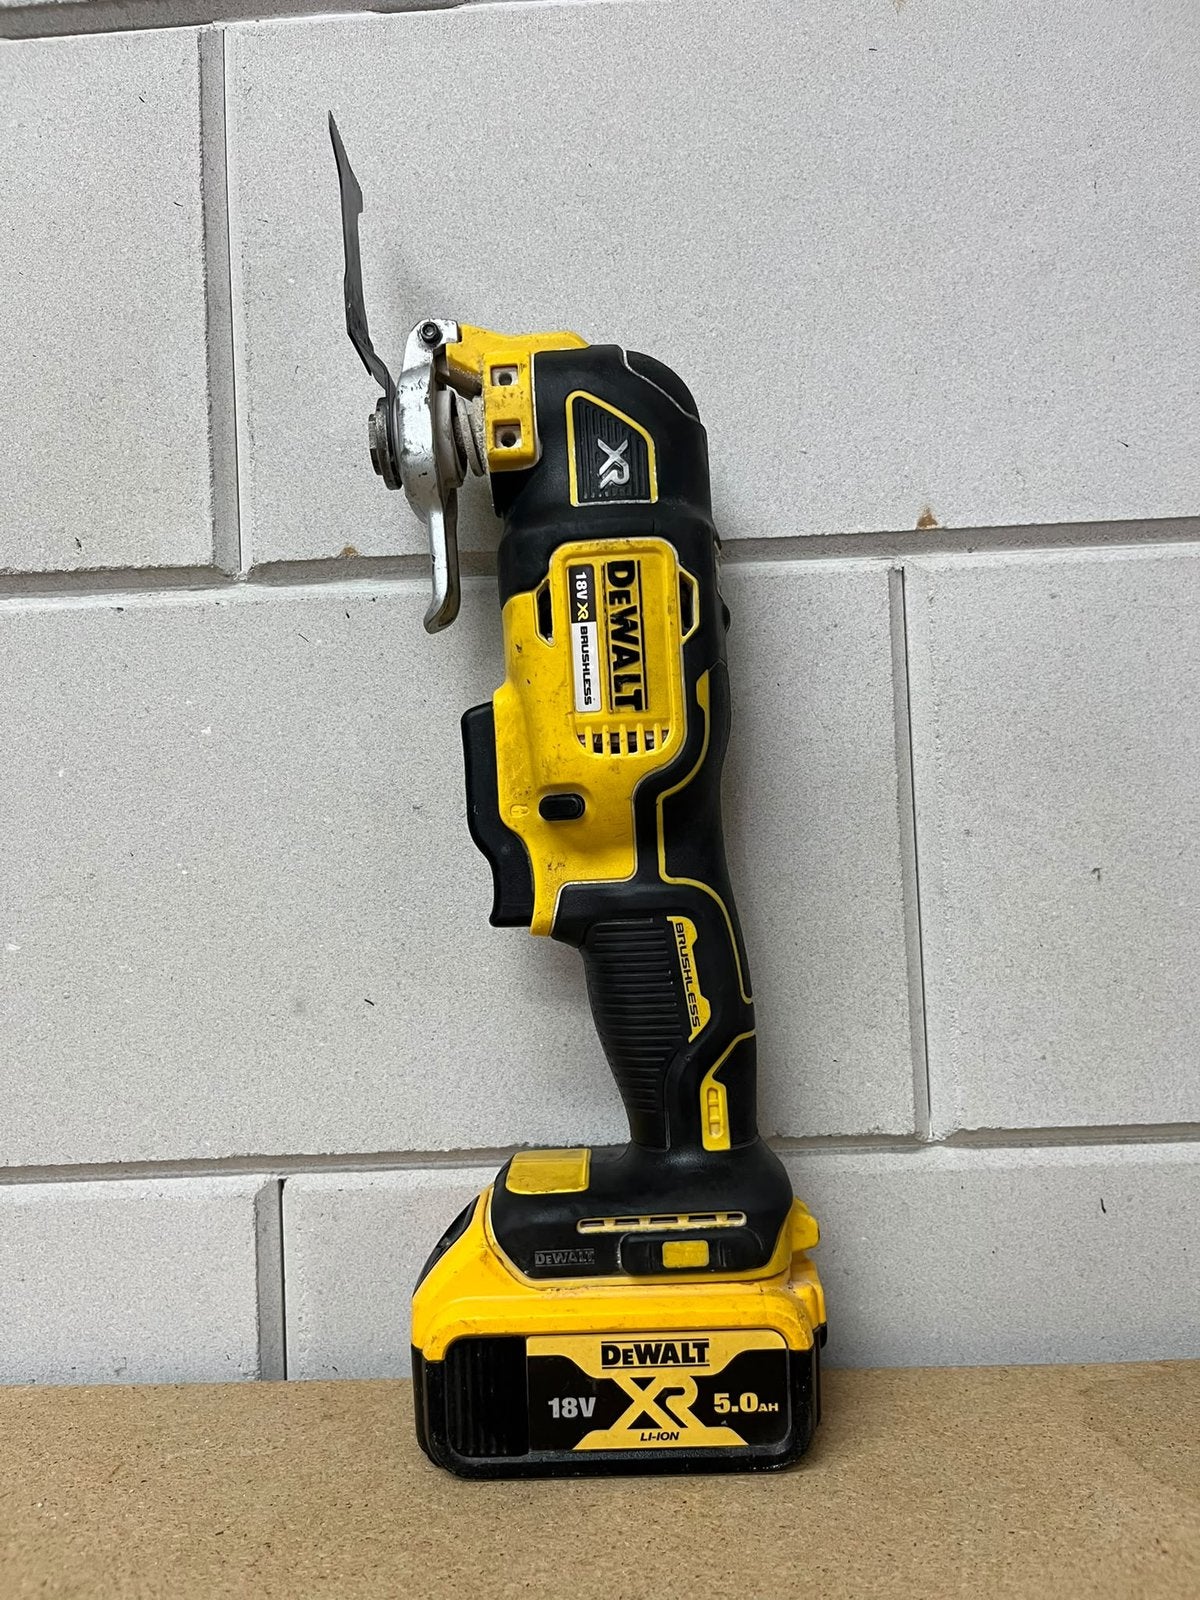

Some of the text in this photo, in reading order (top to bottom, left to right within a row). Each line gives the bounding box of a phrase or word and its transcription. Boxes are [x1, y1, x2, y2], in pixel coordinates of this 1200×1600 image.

[597, 438, 630, 488] XR
[574, 572, 593, 706] 18V XR BRUSHLESS
[675, 922, 701, 1027] BRUSHLESS
[548, 1397, 596, 1418] 18V
[610, 1375, 708, 1429] XR
[640, 1431, 680, 1442] LI-ION
